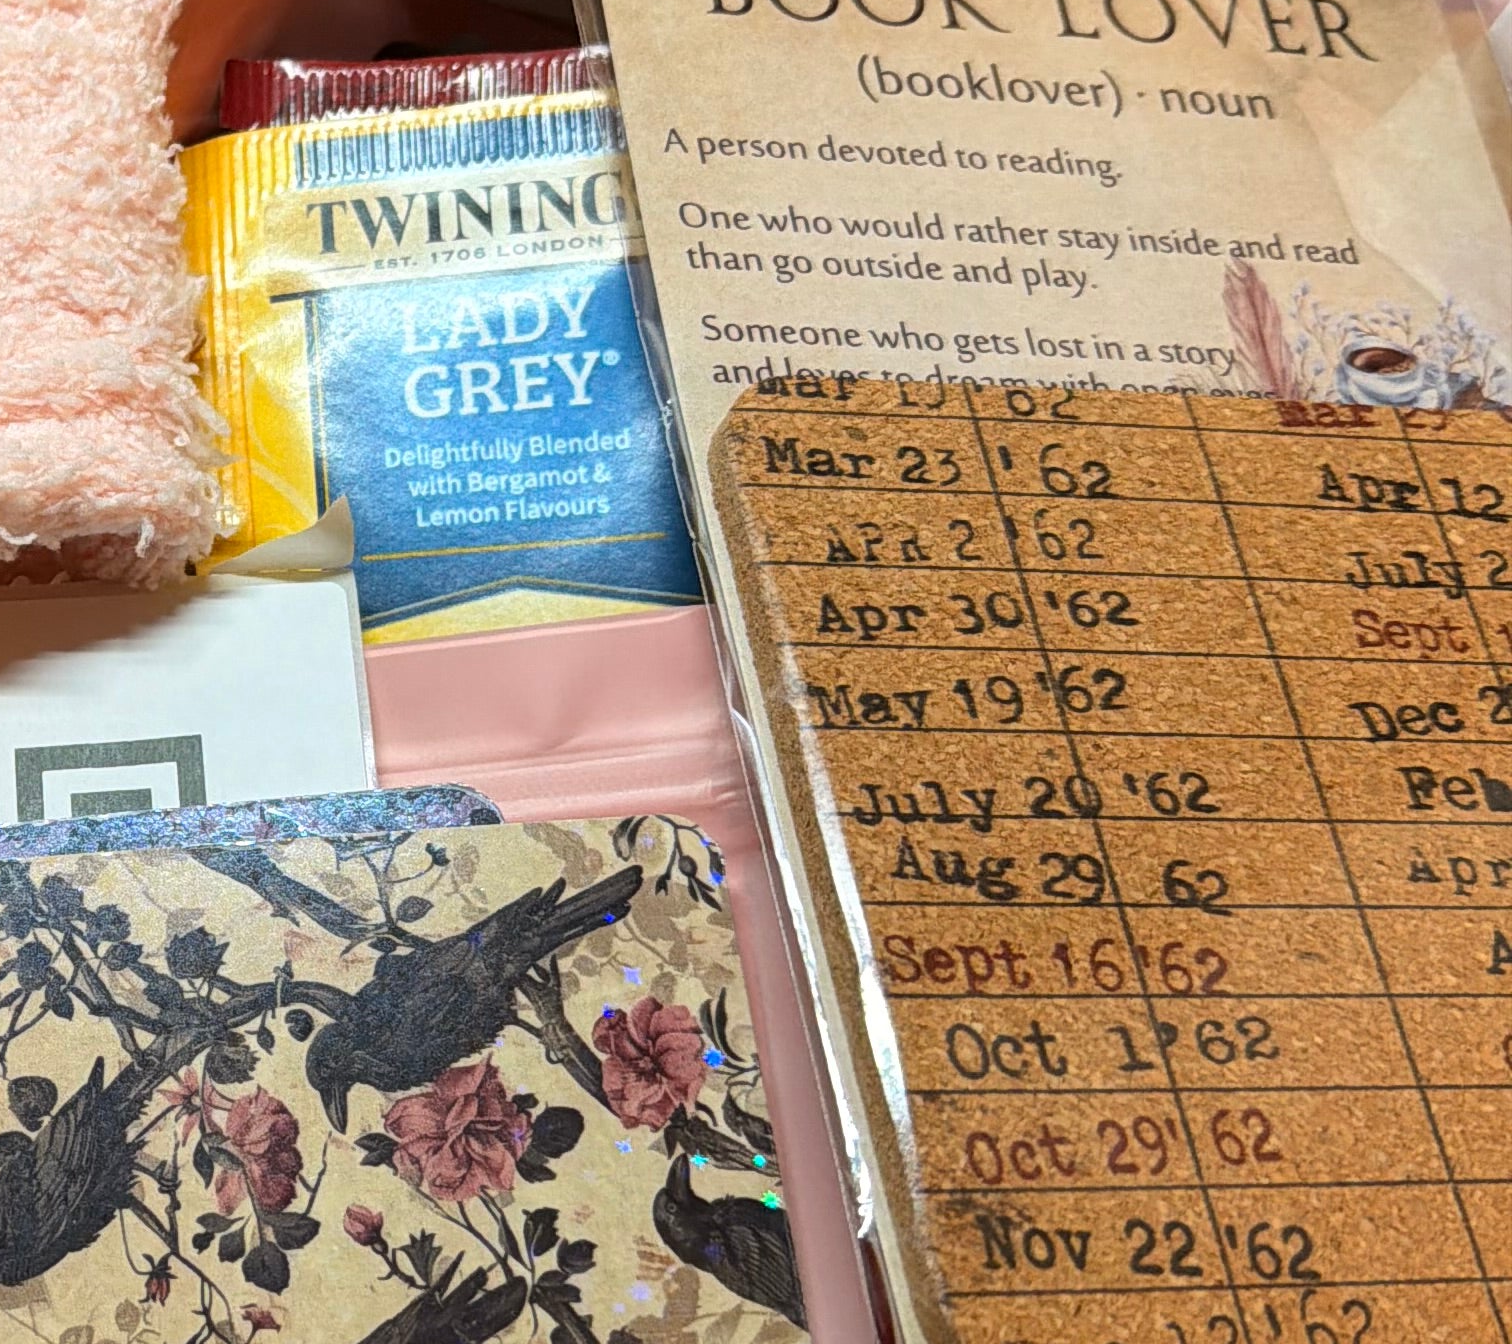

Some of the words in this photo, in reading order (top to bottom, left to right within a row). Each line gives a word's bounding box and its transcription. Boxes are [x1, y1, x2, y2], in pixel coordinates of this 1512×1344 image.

[857, 53, 1123, 118] (booklover)
[1160, 87, 1276, 120] noun
[664, 127, 689, 154] A
[697, 136, 807, 164] person
[818, 134, 947, 168] devoted
[955, 147, 988, 170] to
[997, 147, 1123, 188] reading.
[306, 169, 641, 254] TWINING
[678, 202, 752, 231] One
[757, 205, 832, 235] who
[840, 211, 945, 241] would
[954, 216, 1048, 246] rather
[1057, 228, 1120, 260] stay
[1127, 226, 1222, 257] inside
[1229, 233, 1286, 261] and
[1292, 238, 1360, 265] read
[373, 257, 418, 270] EST.
[430, 247, 487, 263] 1706
[497, 235, 604, 257] LONDON
[686, 241, 763, 272] than
[773, 255, 813, 283] go
[822, 252, 944, 281] outside
[953, 257, 1013, 285] and
[1022, 258, 1098, 299] play.
[401, 284, 596, 354] LADY
[700, 314, 863, 348] Someone
[869, 321, 945, 352] who
[953, 333, 1020, 364] gets
[1025, 327, 1088, 359] lost
[1091, 334, 1125, 362] in
[1133, 343, 1154, 363] a
[1158, 341, 1237, 377] story
[712, 356, 775, 384] and
[384, 438, 523, 469] Delightfully
[529, 428, 631, 457] Blended
[760, 435, 876, 479] Mar
[897, 445, 962, 486] 23
[408, 472, 462, 497] with
[467, 464, 589, 495] Bergamot
[592, 462, 613, 484] &
[1316, 462, 1421, 512] Apr
[416, 505, 500, 528] Lemon
[504, 496, 611, 521] Flavours
[948, 517, 984, 561] 2
[1345, 550, 1465, 599] July
[816, 593, 927, 641] Apr
[948, 590, 1026, 635] 30
[1351, 609, 1471, 660] Sept
[806, 681, 932, 729] May
[952, 674, 1025, 724] 19
[1346, 701, 1466, 743] Dec
[852, 780, 998, 832] July
[1024, 775, 1103, 820] 20
[890, 835, 1022, 902] Aug
[1038, 851, 1107, 905] 29
[1162, 858, 1234, 916] 62
[883, 934, 1032, 994] Sept
[1053, 937, 1125, 992] 16
[945, 1019, 1068, 1080] Oct
[965, 1123, 1076, 1186] Oct
[974, 1213, 1093, 1272] Nov
[1124, 1217, 1205, 1277] 22
